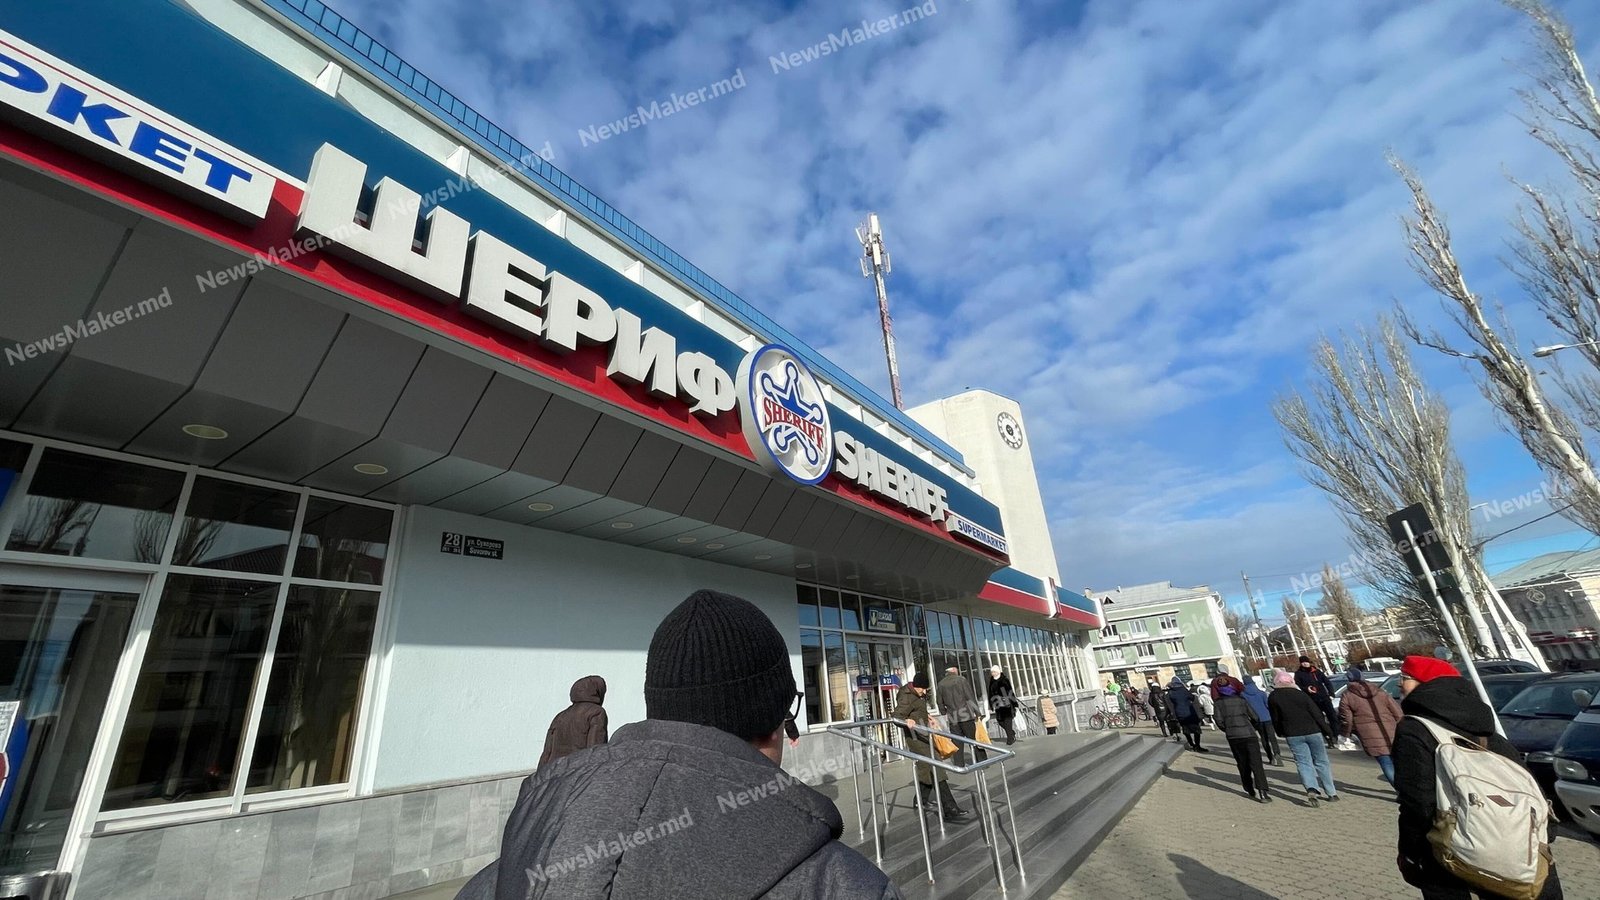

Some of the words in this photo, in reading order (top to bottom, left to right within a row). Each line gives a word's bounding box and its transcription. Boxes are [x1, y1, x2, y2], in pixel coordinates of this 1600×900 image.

[297, 141, 737, 418] ШЕРИФ
[763, 396, 825, 449] SHERIFF
[834, 430, 949, 522] SHERIFF
[445, 533, 460, 546] 28
[957, 519, 1007, 553] SUPERMARKET
